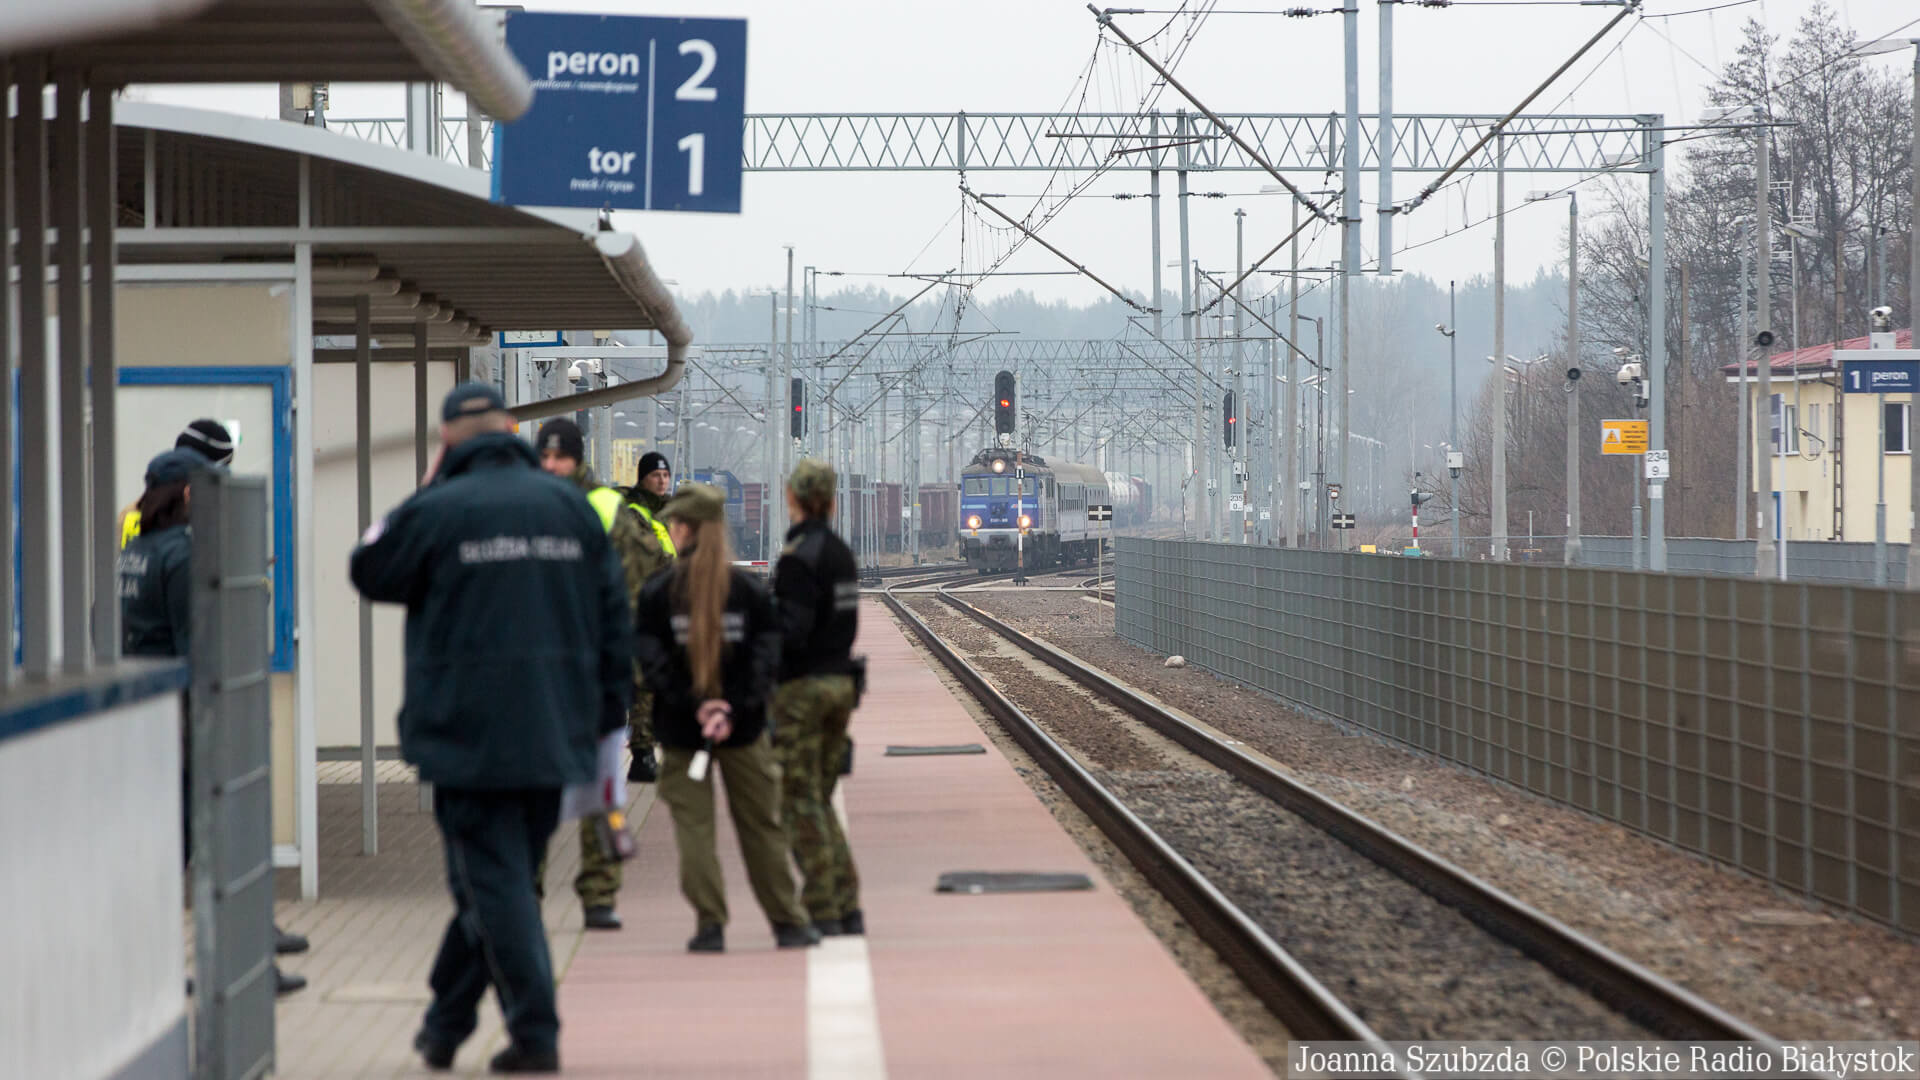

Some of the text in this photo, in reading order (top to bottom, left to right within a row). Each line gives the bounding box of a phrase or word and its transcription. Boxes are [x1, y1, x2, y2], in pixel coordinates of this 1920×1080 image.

[548, 38, 718, 101] peron 2
[588, 133, 705, 196] tor 1
[1850, 370, 1909, 389] 1 peron
[1647, 452, 1668, 462] 234
[1652, 466, 1659, 476] 9
